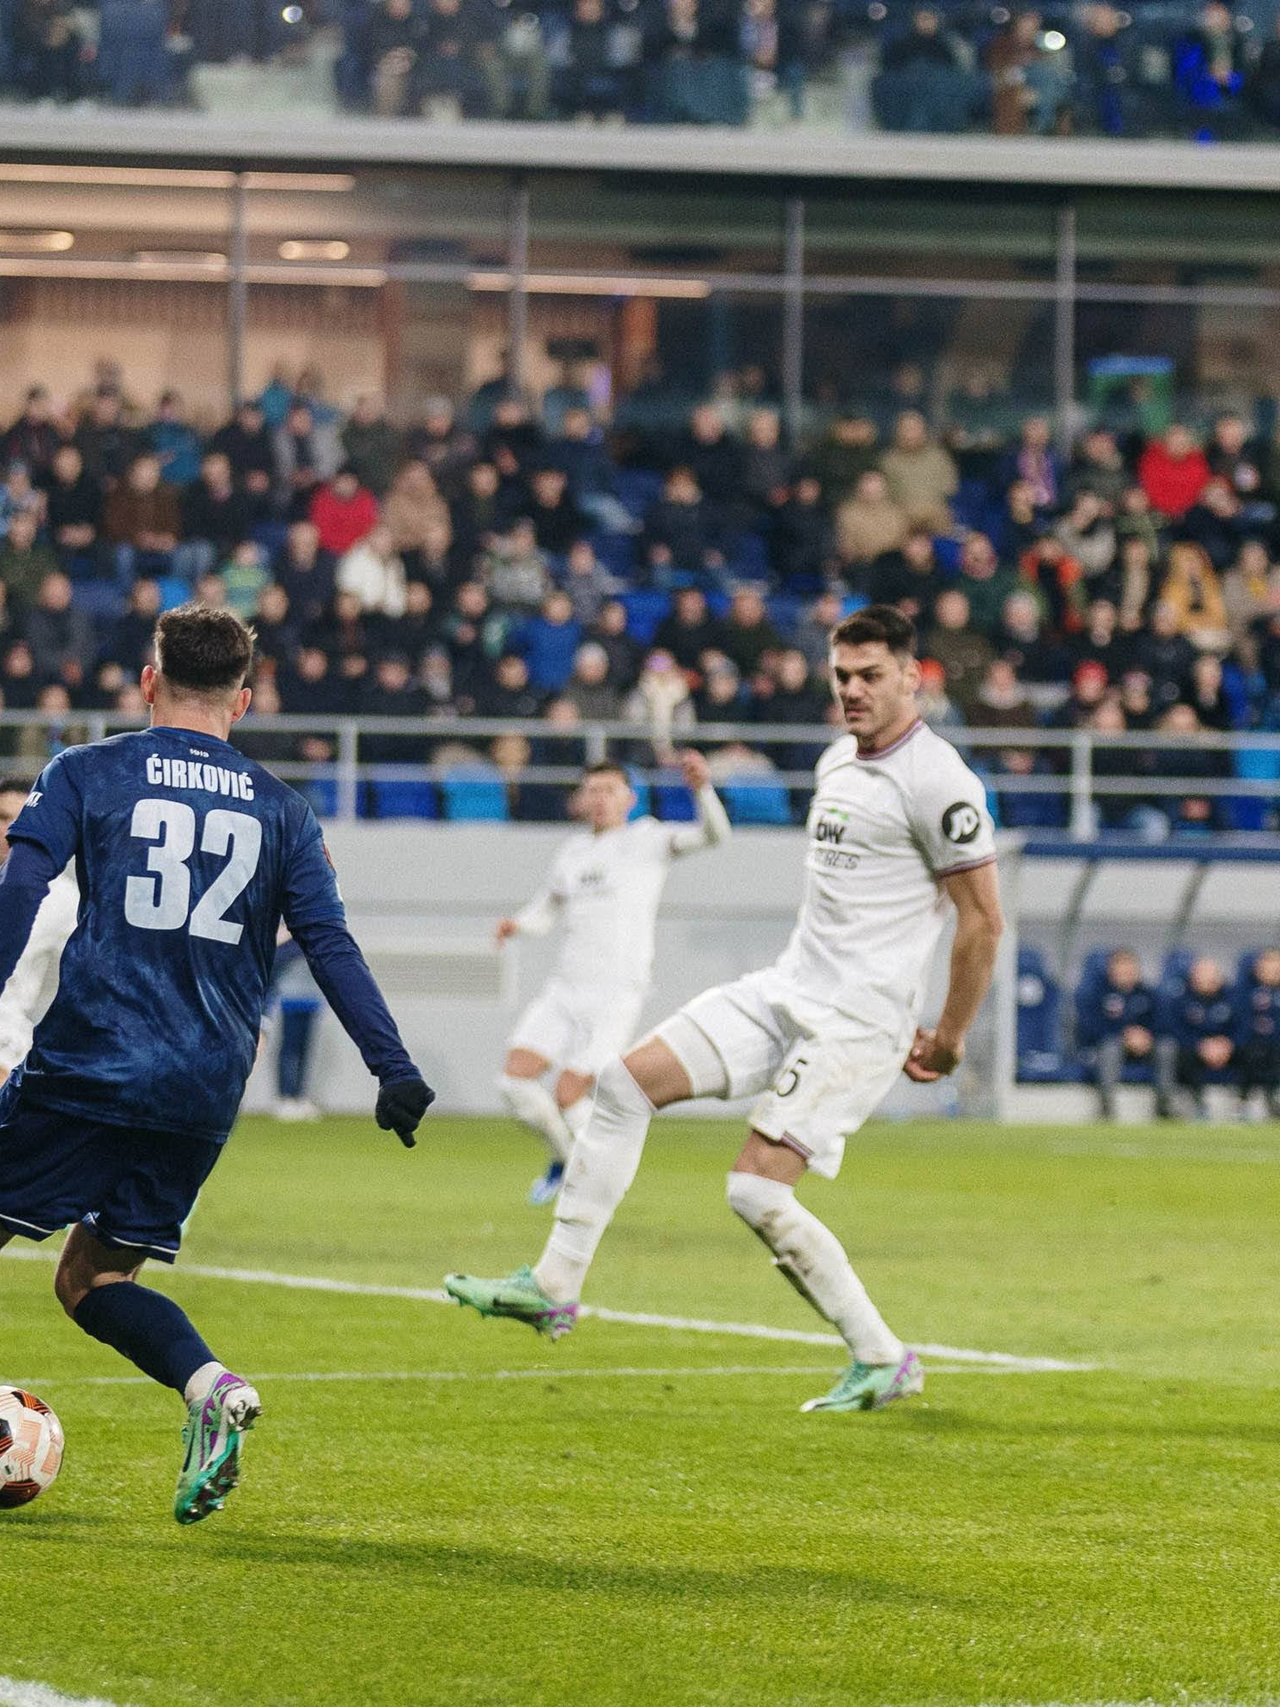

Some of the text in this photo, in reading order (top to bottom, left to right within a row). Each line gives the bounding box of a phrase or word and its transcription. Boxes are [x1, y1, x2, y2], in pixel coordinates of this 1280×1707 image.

[146, 753, 254, 801] ĆIRKOVIĆ
[125, 799, 262, 945] 32
[776, 1058, 807, 1097] 5
